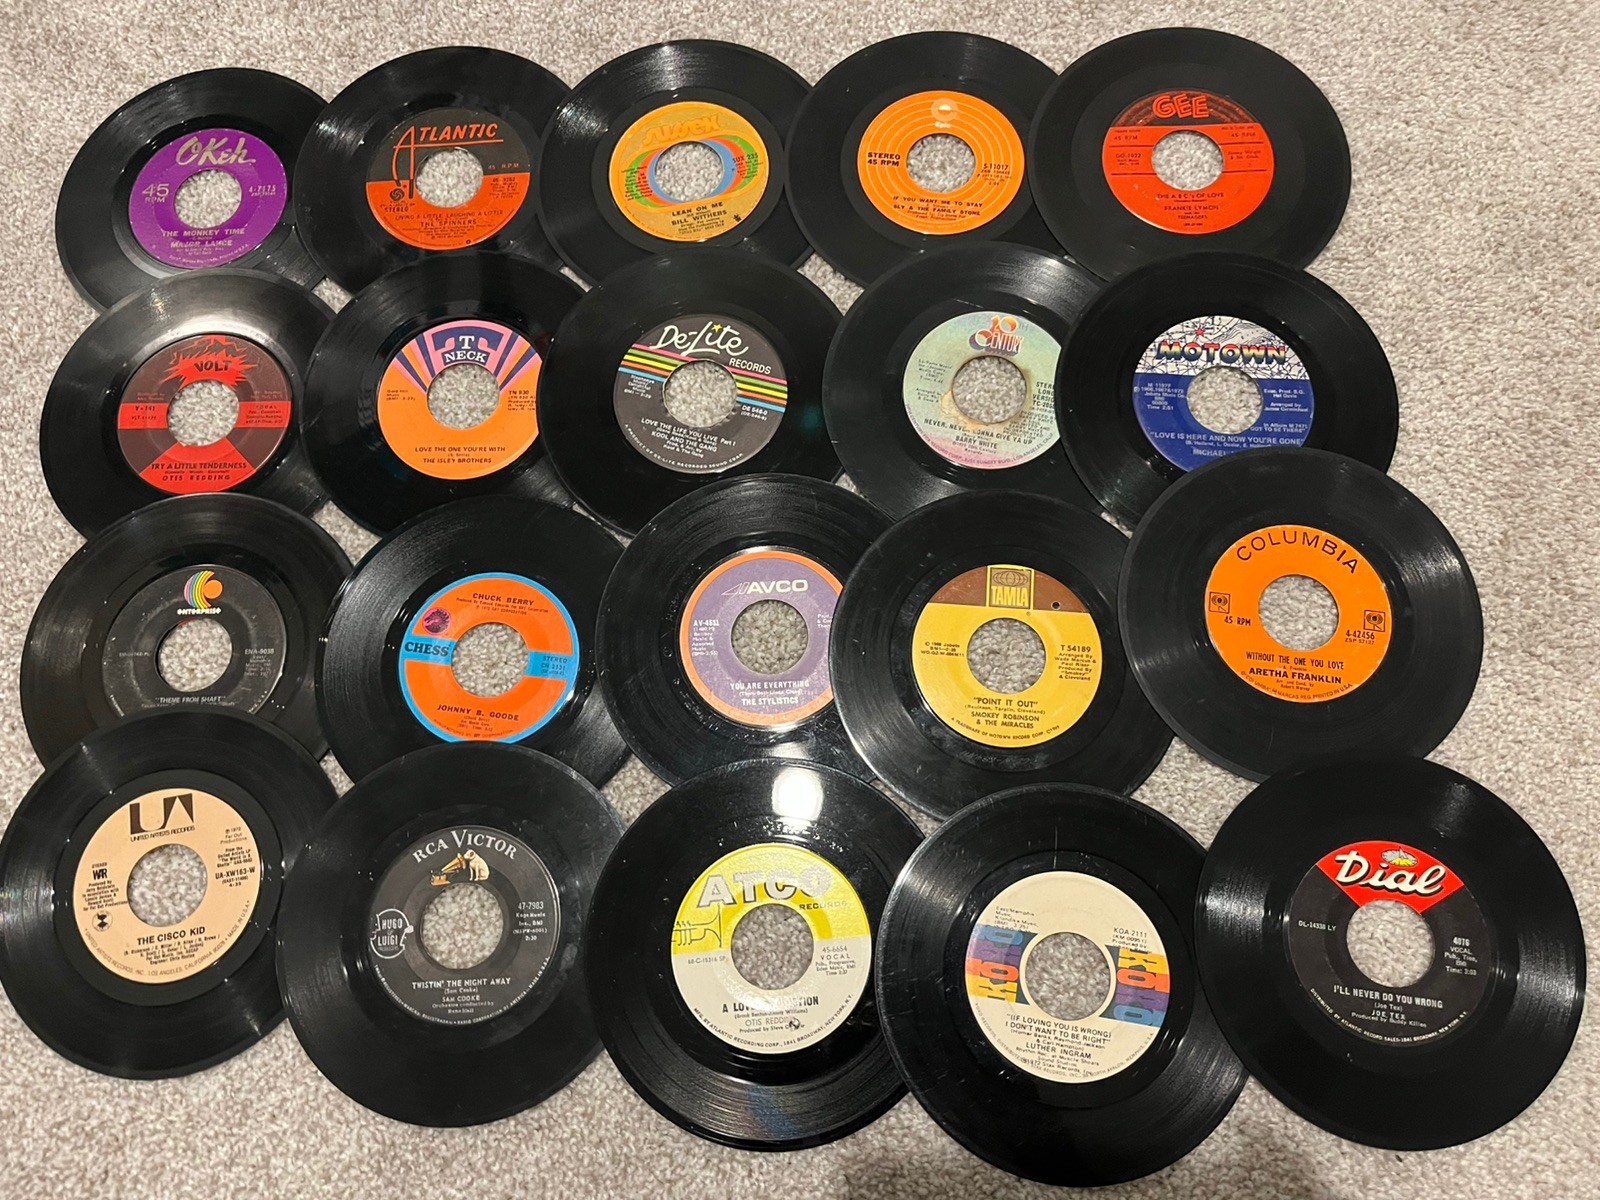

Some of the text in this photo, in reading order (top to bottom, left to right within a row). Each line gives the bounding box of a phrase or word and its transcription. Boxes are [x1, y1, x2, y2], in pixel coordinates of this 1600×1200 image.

[1153, 94, 1209, 118] GEE
[867, 152, 901, 160] STEREO
[142, 184, 169, 197] 45
[672, 209, 692, 217] LEAN
[692, 210, 727, 221] WITHERS
[991, 315, 1019, 334] 20
[459, 336, 474, 349] T
[969, 329, 1024, 356] CENTURY
[444, 351, 487, 363] NECK
[1156, 340, 1287, 365] MOTOWN
[194, 360, 232, 372] VOLT
[729, 358, 772, 374] RECORDS
[652, 431, 669, 441] KOOL
[670, 436, 685, 444] AND
[699, 443, 717, 452] GANG
[955, 436, 977, 444] BARRY
[979, 440, 997, 449] WHITE
[1236, 530, 1359, 574] COLUMBIA
[746, 579, 809, 594] AVCO
[473, 593, 534, 606] CHUCK BERRY
[991, 586, 1029, 607] TAMLA
[1224, 616, 1251, 627] 45 RPM
[1345, 629, 1375, 640] 4-42456
[404, 641, 449, 657] CHESS
[1245, 651, 1344, 670] WITHOUT THE ONE YOU LOVE
[1249, 668, 1342, 684] ARETHA FRANKLIN
[730, 680, 810, 690] YOU ARE EVERYTHING
[742, 696, 799, 706] THE STYLISTICS
[974, 697, 1001, 706] "POINT
[1017, 700, 1038, 708] OUT"
[437, 704, 520, 721] JOHNNY B. GOODE
[971, 711, 1040, 722] SMOKEY ROBINSON
[1001, 721, 1034, 729] MIRACLES
[129, 793, 194, 835] UA
[412, 828, 518, 864] RCA VICTOR
[215, 867, 256, 880] UA-XW163-W
[1335, 850, 1446, 897] Dial
[697, 865, 834, 908] ATCO
[518, 902, 544, 910] 47-7983
[382, 919, 403, 929] HUGO
[137, 926, 206, 946] THE CISCO KID
[1113, 927, 1147, 938] KOA 2111
[377, 936, 398, 946] LUIGI
[1453, 936, 1470, 946] 4076
[1450, 946, 1472, 954] VOCAL
[412, 977, 511, 990] TWISTIN' THE NIGHT AWAY
[1334, 984, 1444, 1008] I'LL NEVER DO YOU WRONG
[1390, 1012, 1406, 1020] TEX
[1010, 1022, 1033, 1032] DON'T
[1034, 1026, 1057, 1035] WANT
[1059, 1030, 1069, 1038] TO
[1082, 1035, 1111, 1045] RIGHT"
[1022, 1017, 1052, 1028] LOVING
[1054, 1022, 1070, 1030] YOU
[1080, 1027, 1112, 1038] WRONG)
[1026, 1042, 1092, 1058] LUTHER INGRAM
